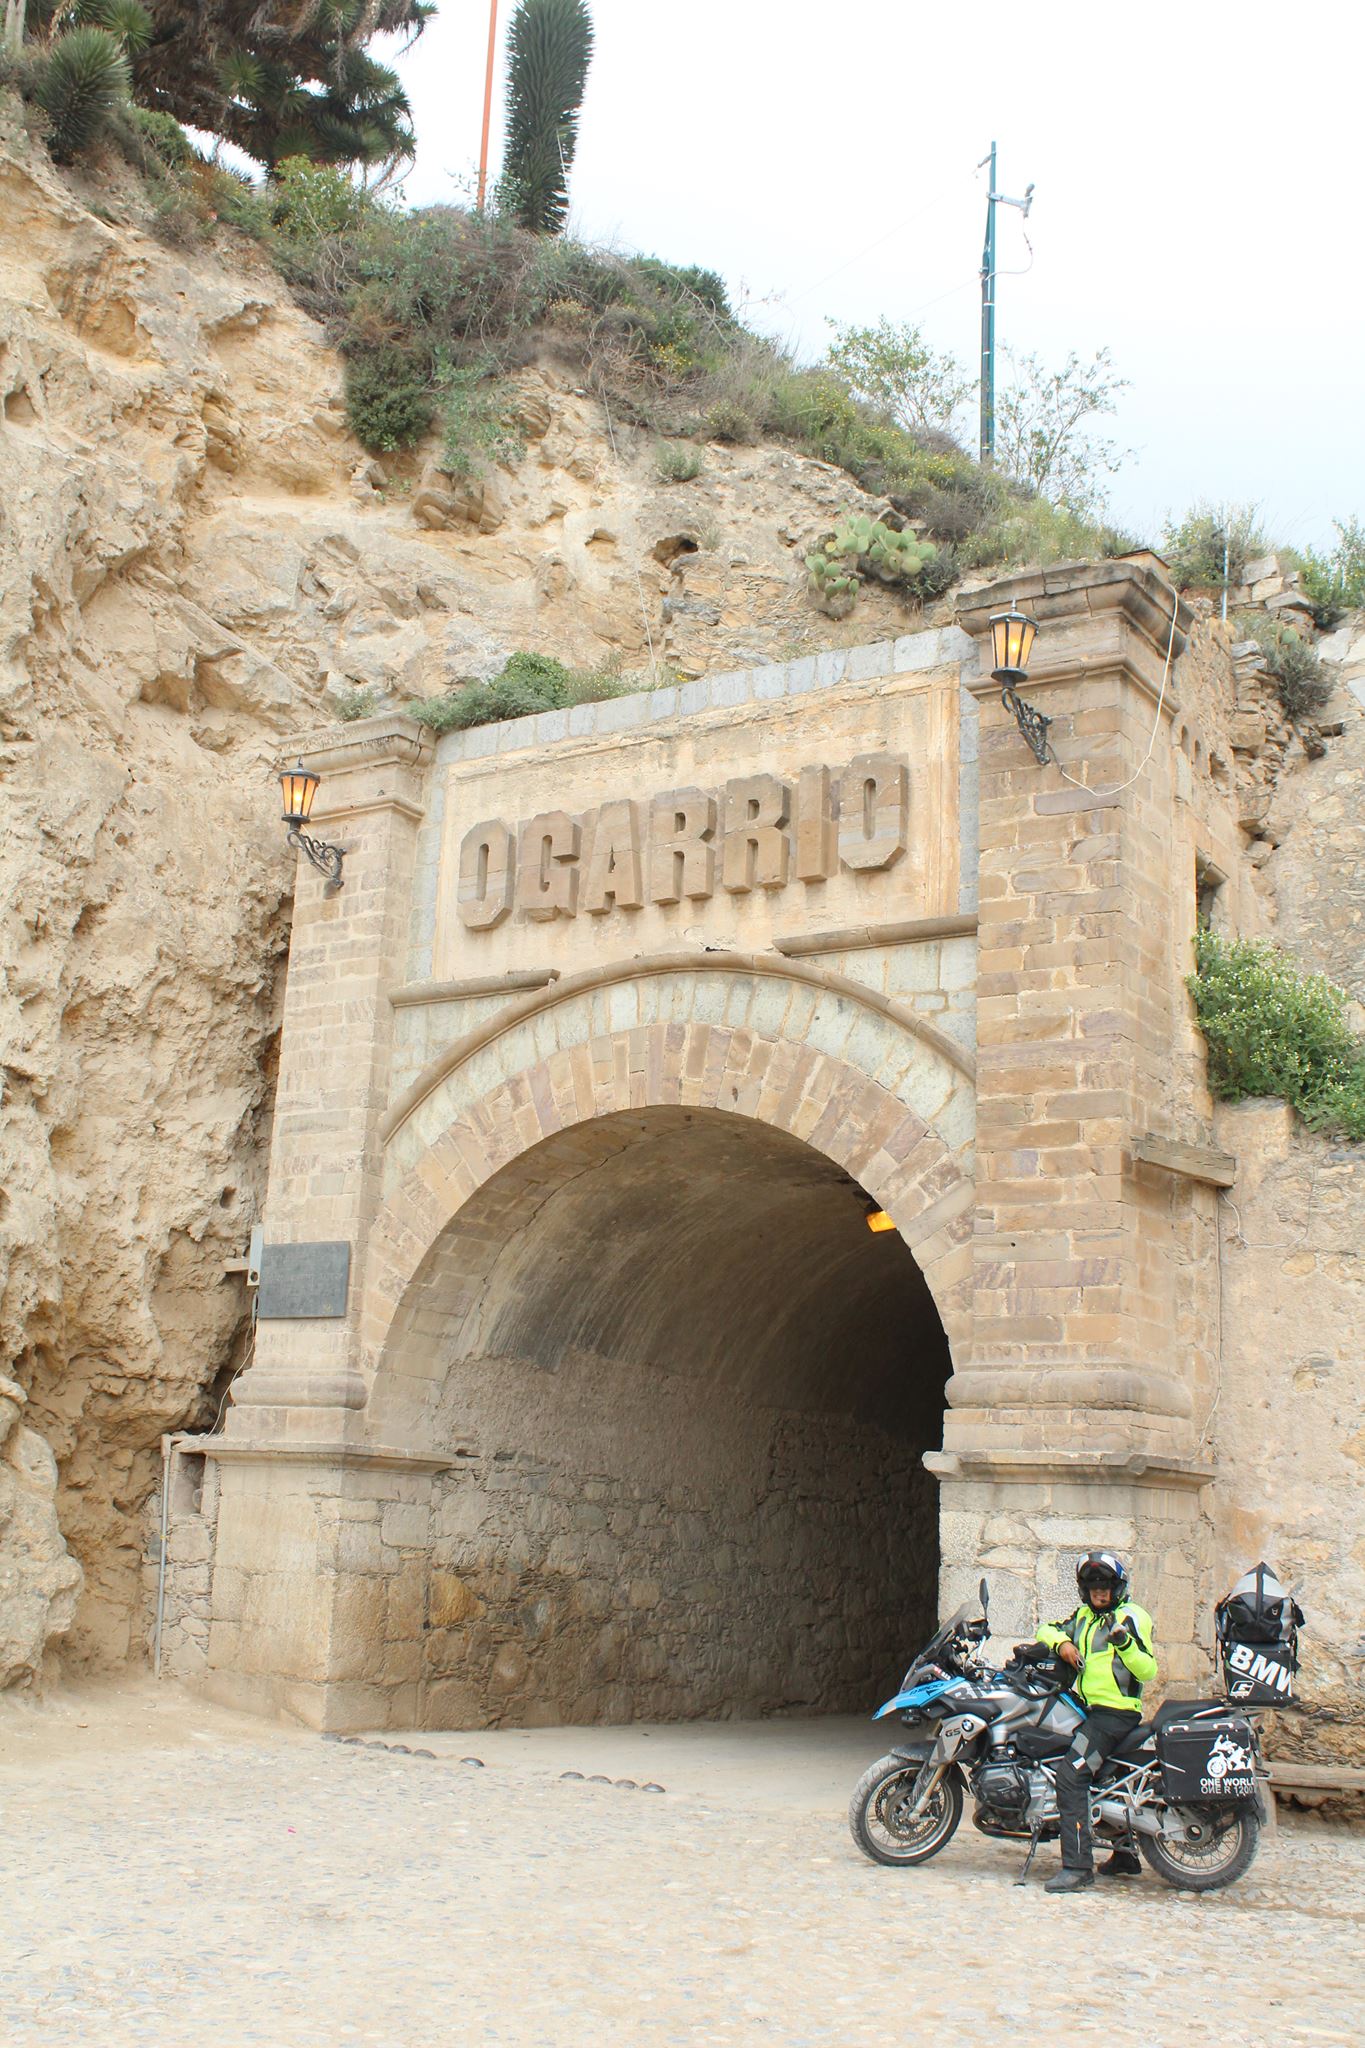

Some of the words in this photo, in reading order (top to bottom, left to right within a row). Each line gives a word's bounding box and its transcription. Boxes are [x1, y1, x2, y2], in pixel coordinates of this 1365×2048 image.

[457, 753, 908, 932] OGARRIO
[945, 1727, 961, 1738] GS
[1199, 1777, 1221, 1787] ONE
